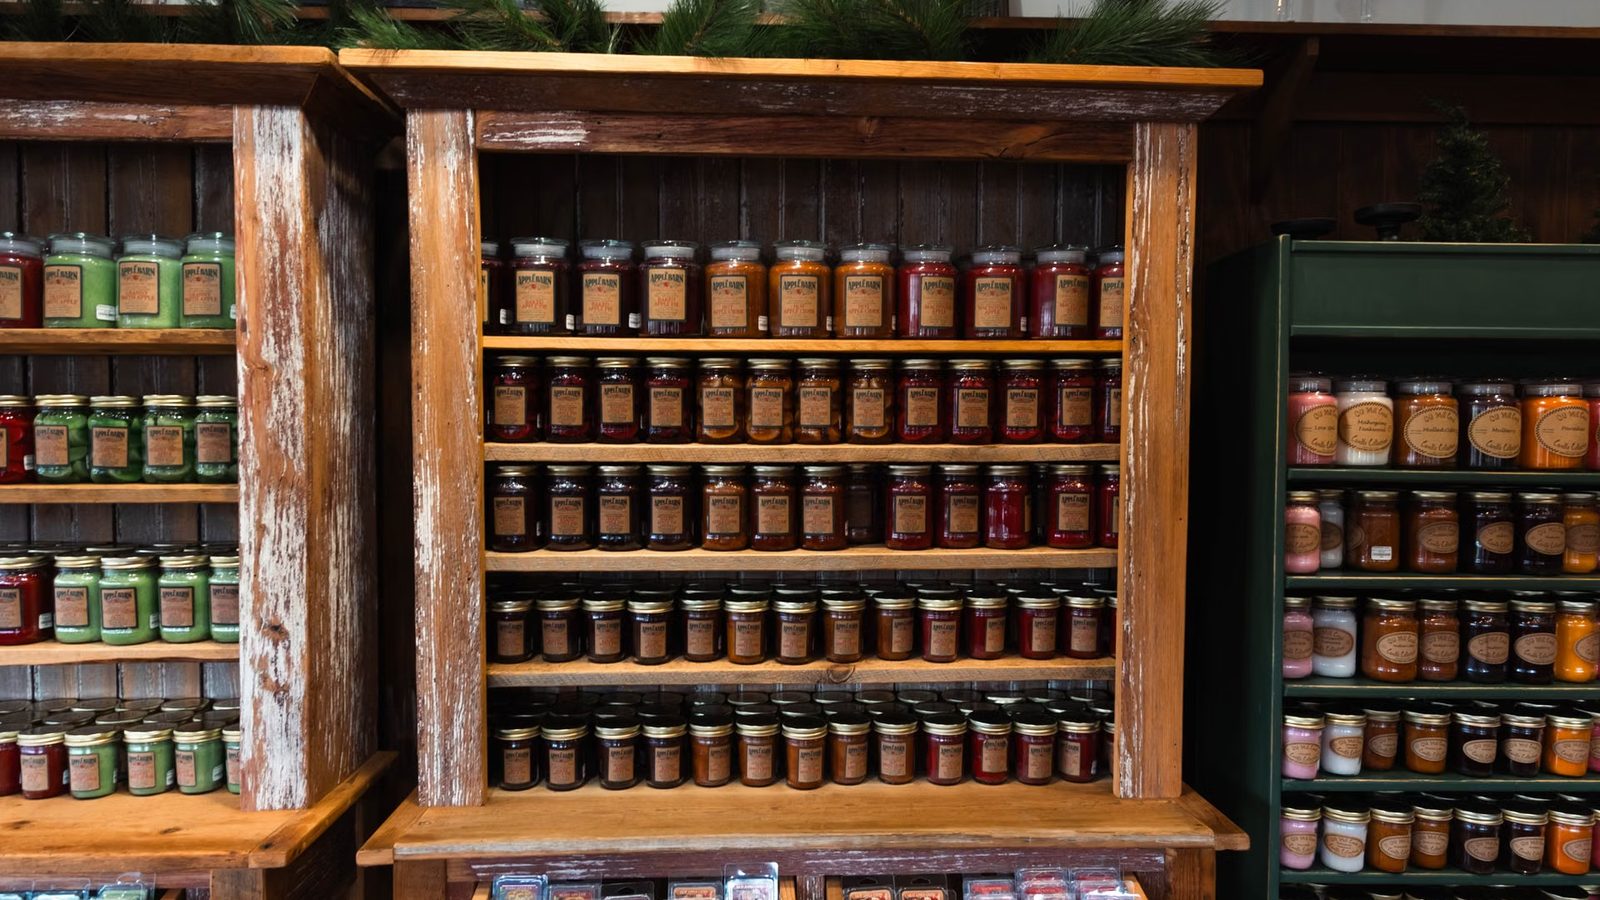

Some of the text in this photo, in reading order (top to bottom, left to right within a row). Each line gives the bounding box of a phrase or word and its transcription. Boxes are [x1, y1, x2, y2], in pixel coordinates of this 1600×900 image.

[61, 271, 77, 281] BARN
[138, 267, 155, 276] BARN
[202, 268, 218, 278] BARN
[536, 276, 552, 285] BARN
[668, 274, 683, 282] BARN
[602, 278, 617, 288] BARN
[729, 281, 744, 289] BARN
[801, 281, 816, 289] BARN
[865, 281, 881, 290] BARN
[994, 282, 1009, 291] BARN
